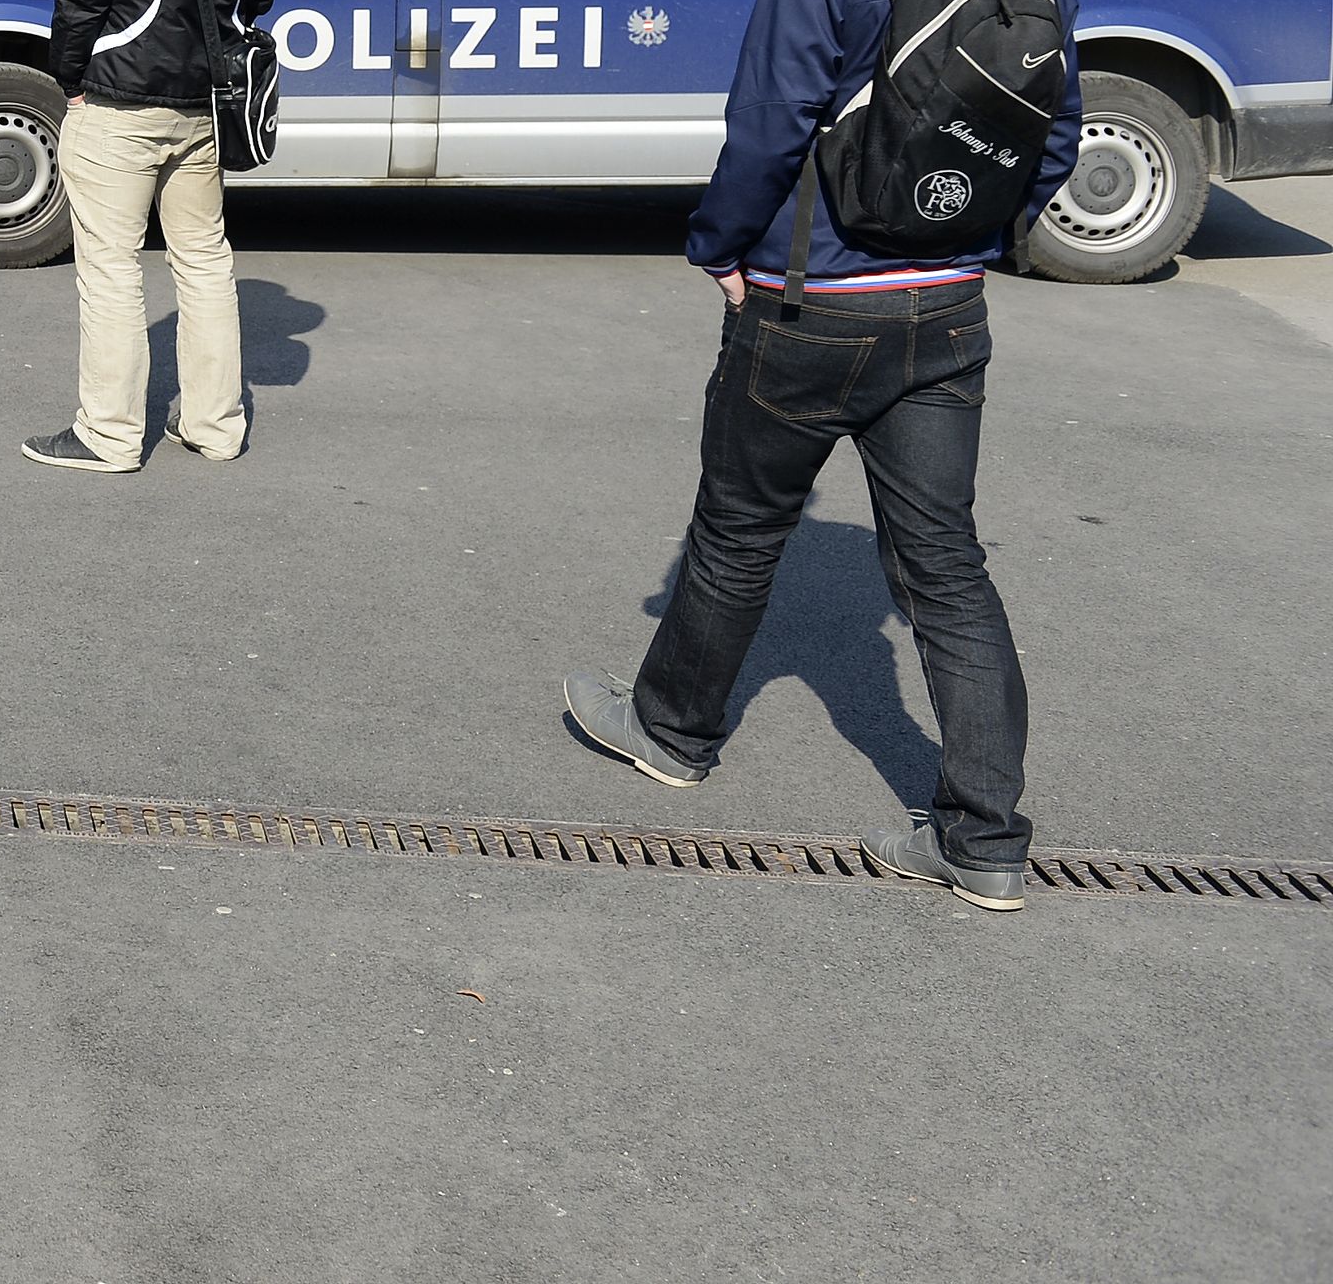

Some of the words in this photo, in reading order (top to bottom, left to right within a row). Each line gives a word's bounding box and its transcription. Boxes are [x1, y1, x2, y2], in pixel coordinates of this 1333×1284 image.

[270, 6, 603, 71] OLIZEI
[937, 120, 994, 155] Johnny's
[992, 148, 1020, 168] Pub
